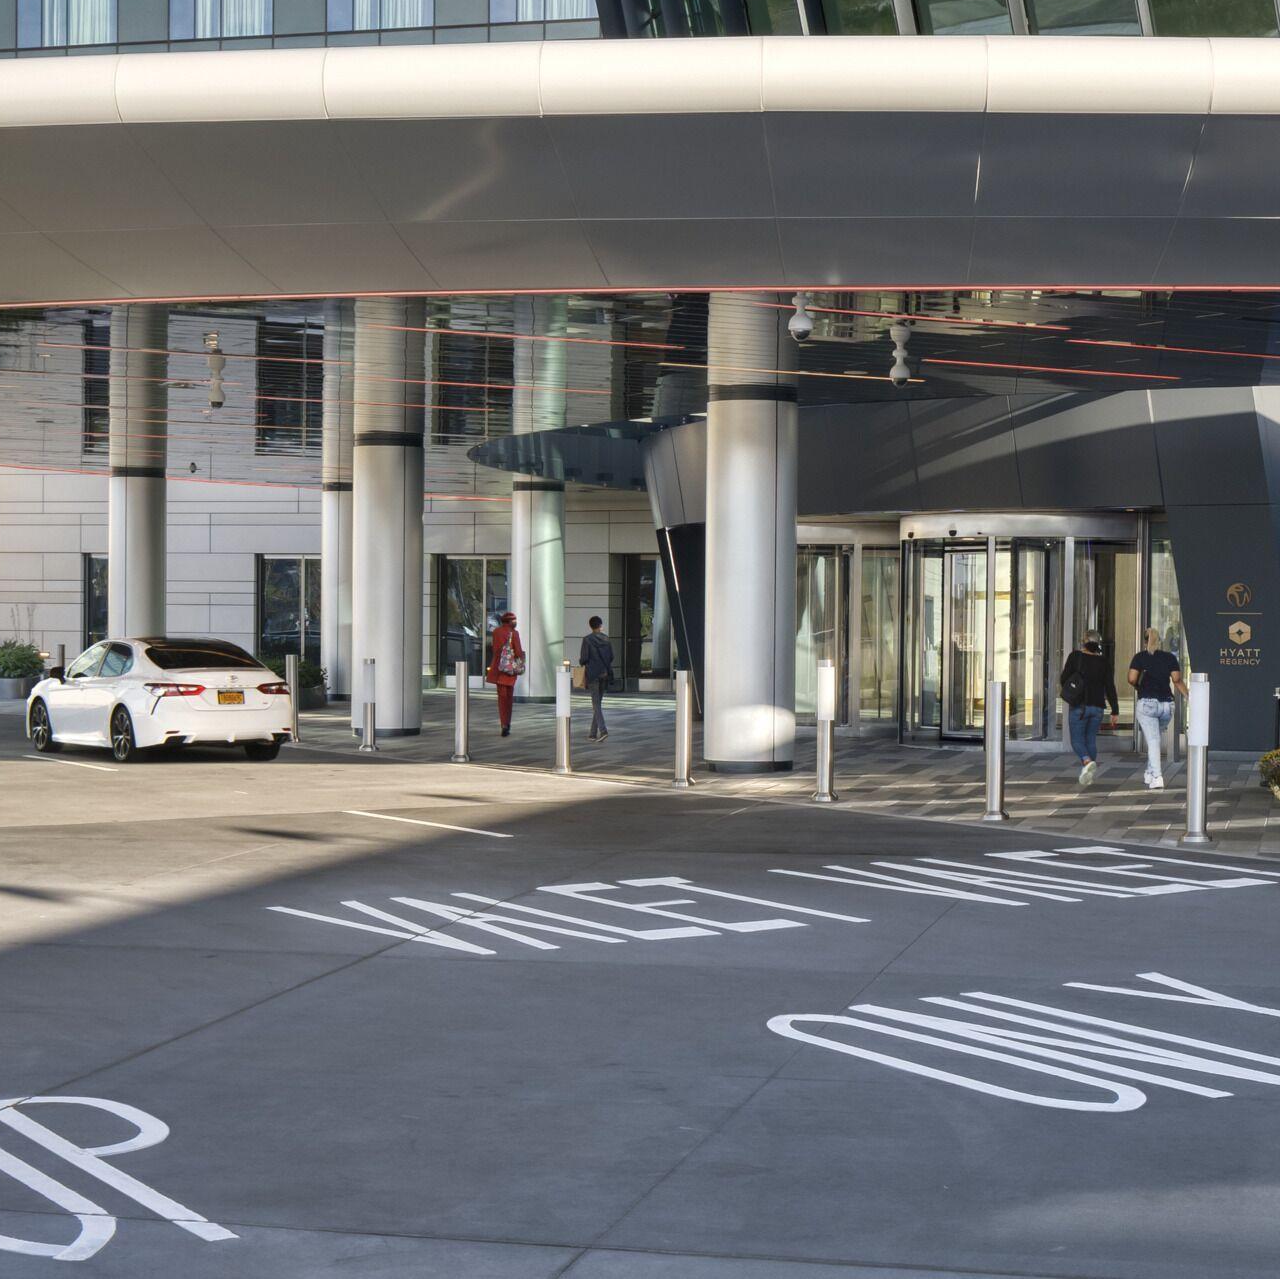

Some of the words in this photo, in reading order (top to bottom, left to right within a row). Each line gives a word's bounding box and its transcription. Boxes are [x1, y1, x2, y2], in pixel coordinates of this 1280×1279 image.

[1219, 648, 1261, 658] HYATT
[1219, 658, 1261, 666] REGENCY
[265, 876, 873, 956] VALET
